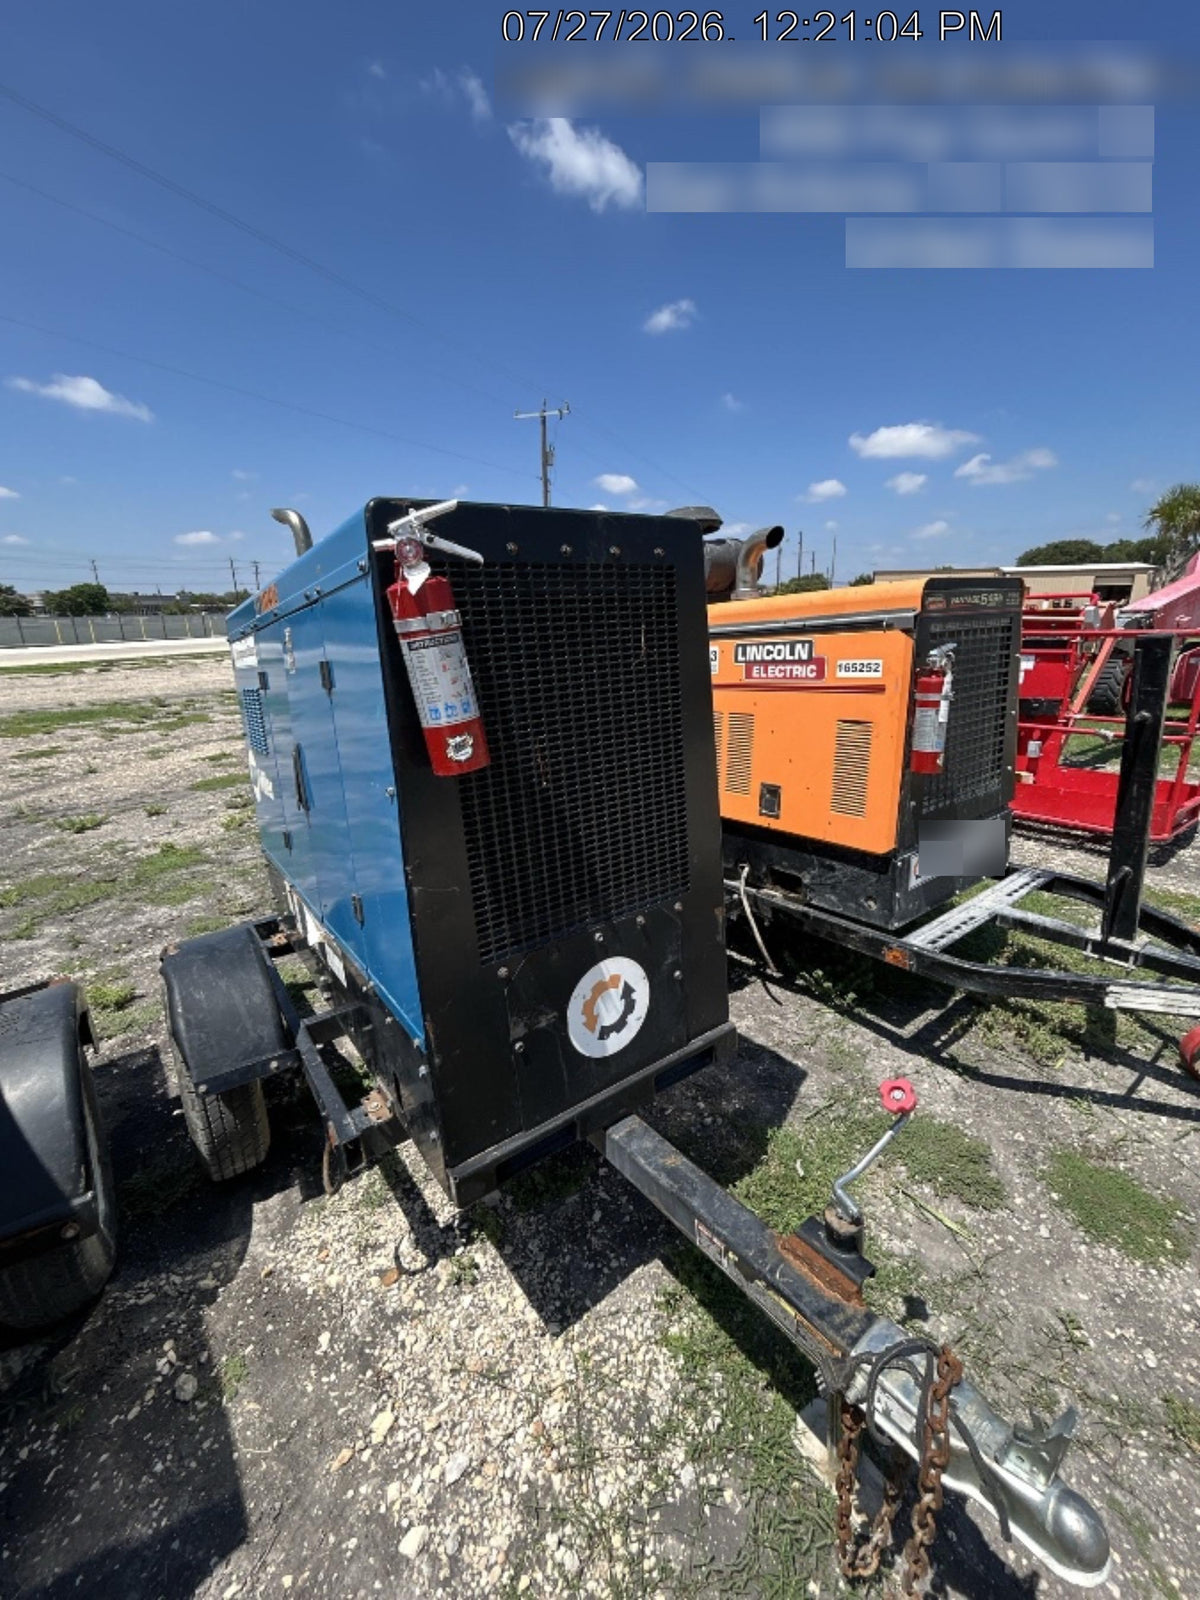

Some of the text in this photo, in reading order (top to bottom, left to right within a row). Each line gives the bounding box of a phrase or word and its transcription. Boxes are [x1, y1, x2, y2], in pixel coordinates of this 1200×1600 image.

[737, 643, 809, 661] LINCOLN
[752, 664, 817, 678] ELECTRIC
[838, 662, 881, 673] 165252
